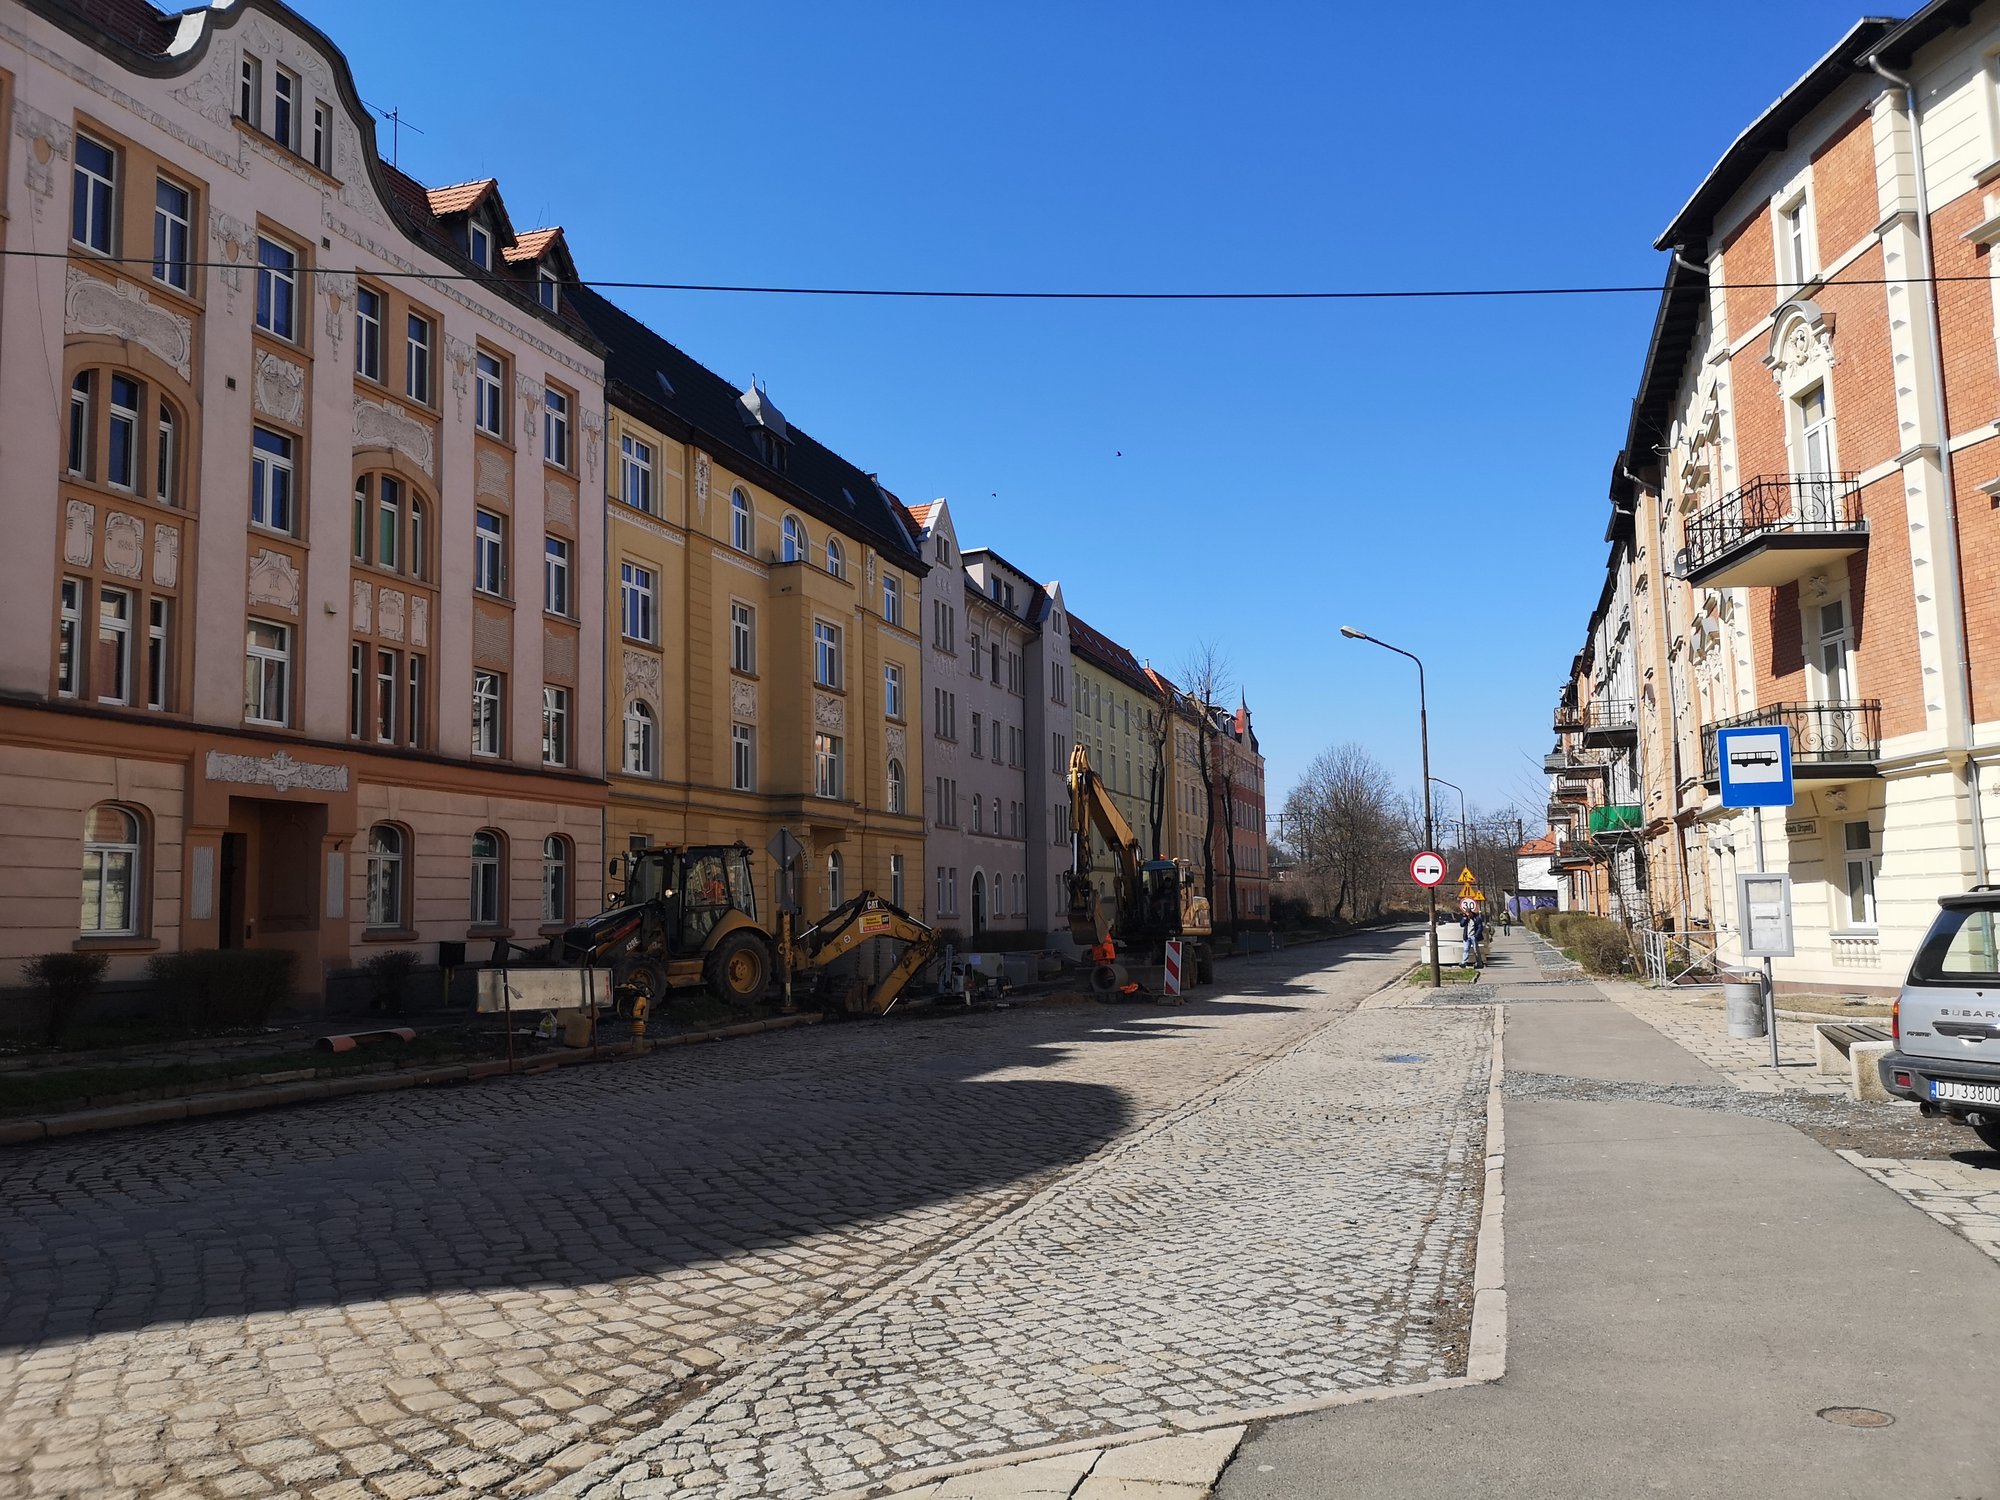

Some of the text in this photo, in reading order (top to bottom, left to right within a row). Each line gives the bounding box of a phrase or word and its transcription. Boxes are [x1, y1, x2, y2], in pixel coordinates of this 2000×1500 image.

[867, 900, 878, 909] CAT
[1462, 901, 1475, 910] 30
[1940, 1009, 2000, 1017] SUBAR
[1939, 1081, 2000, 1102] DJ 33800
